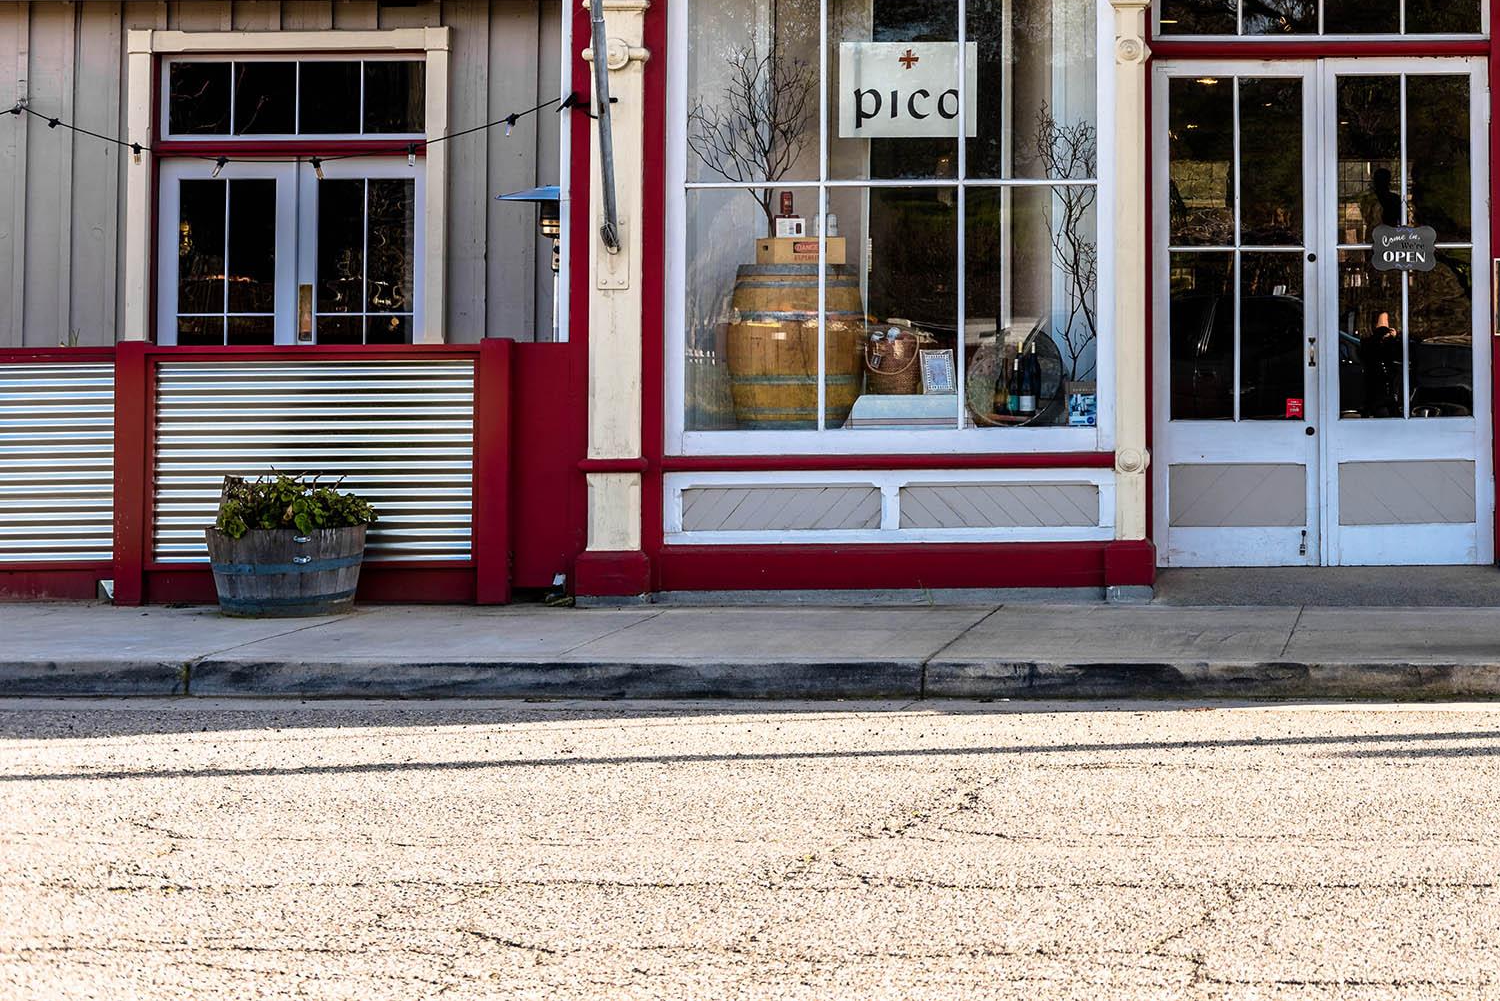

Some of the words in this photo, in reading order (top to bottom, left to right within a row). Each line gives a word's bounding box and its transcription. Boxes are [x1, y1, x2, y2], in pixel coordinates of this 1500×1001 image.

[853, 88, 960, 129] pico
[1382, 235, 1406, 247] Come
[1383, 250, 1426, 263] OPEN
